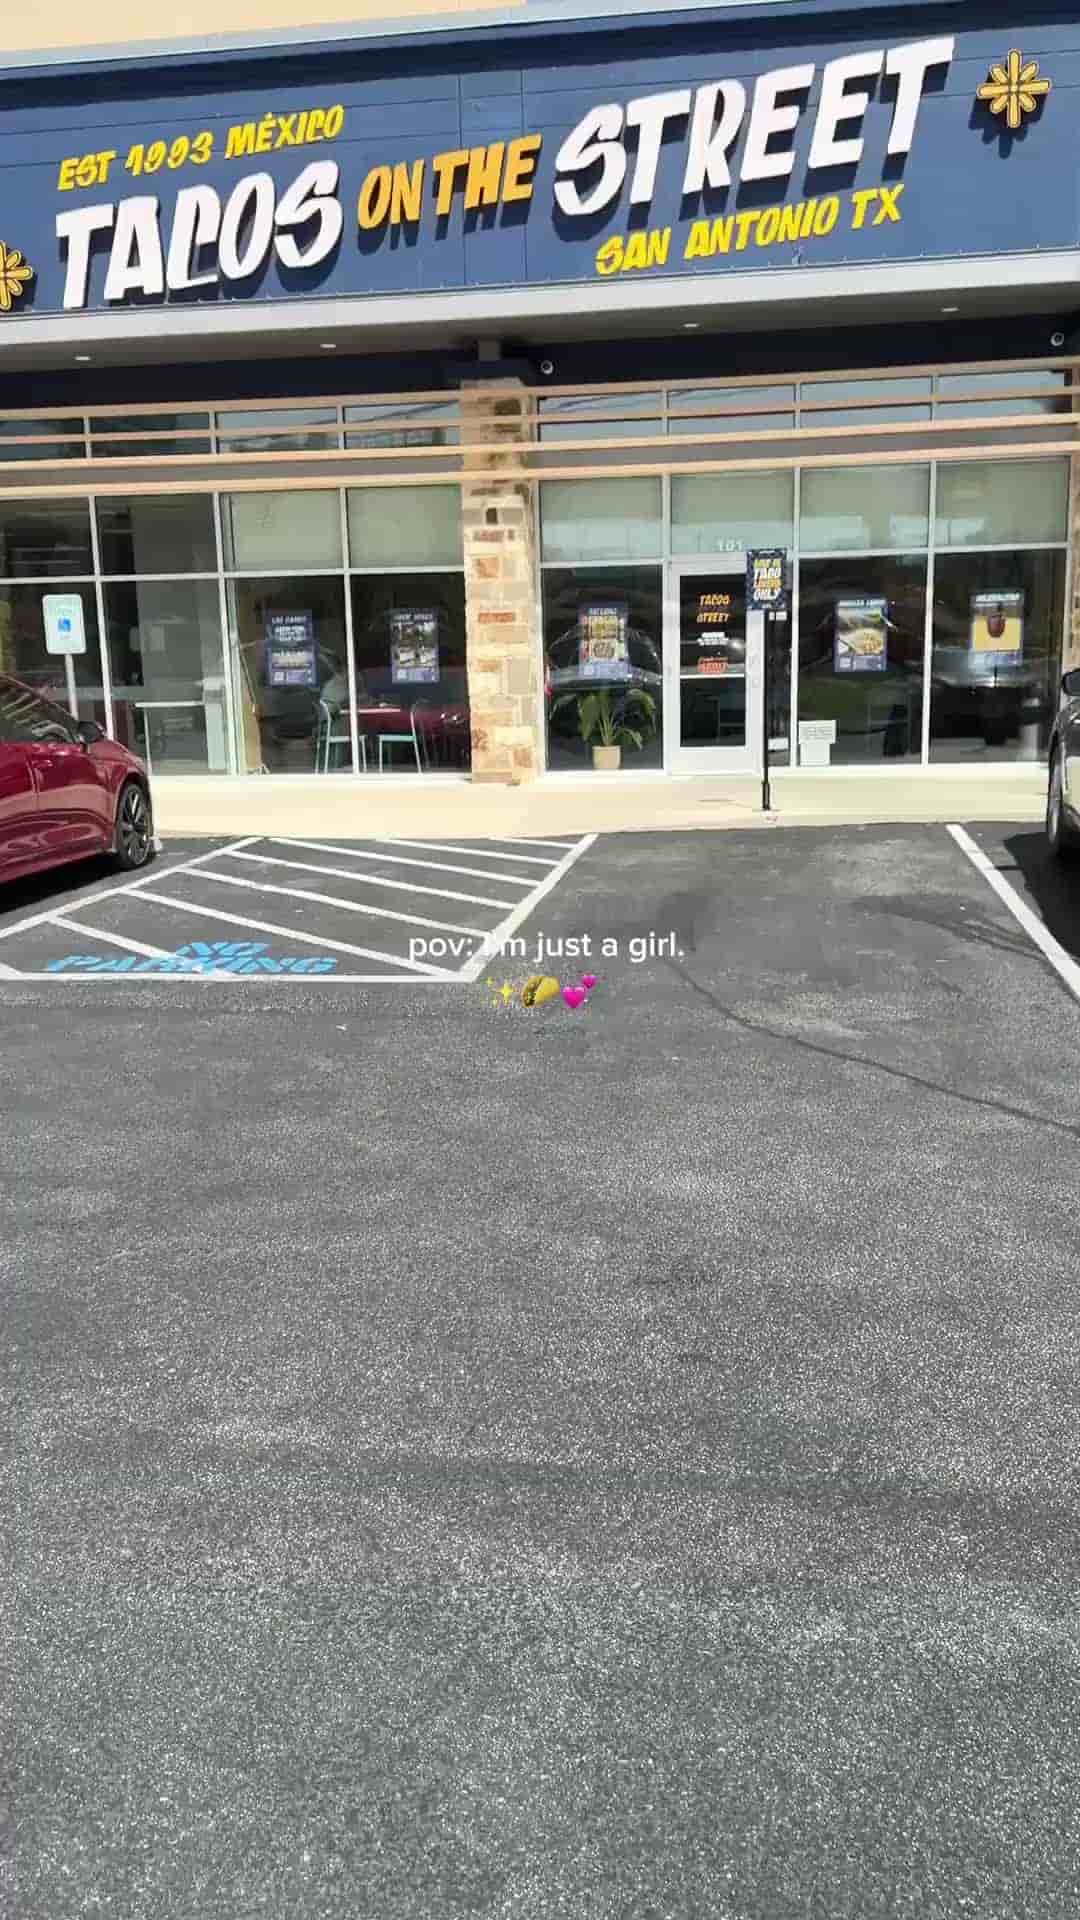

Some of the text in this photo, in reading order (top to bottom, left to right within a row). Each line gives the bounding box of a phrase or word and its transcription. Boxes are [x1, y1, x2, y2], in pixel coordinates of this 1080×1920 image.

[55, 36, 955, 309] TACOS ON THE STREET
[58, 151, 114, 190] EST
[125, 132, 213, 177] 1993
[595, 183, 905, 275] SAN ANTONIO TX
